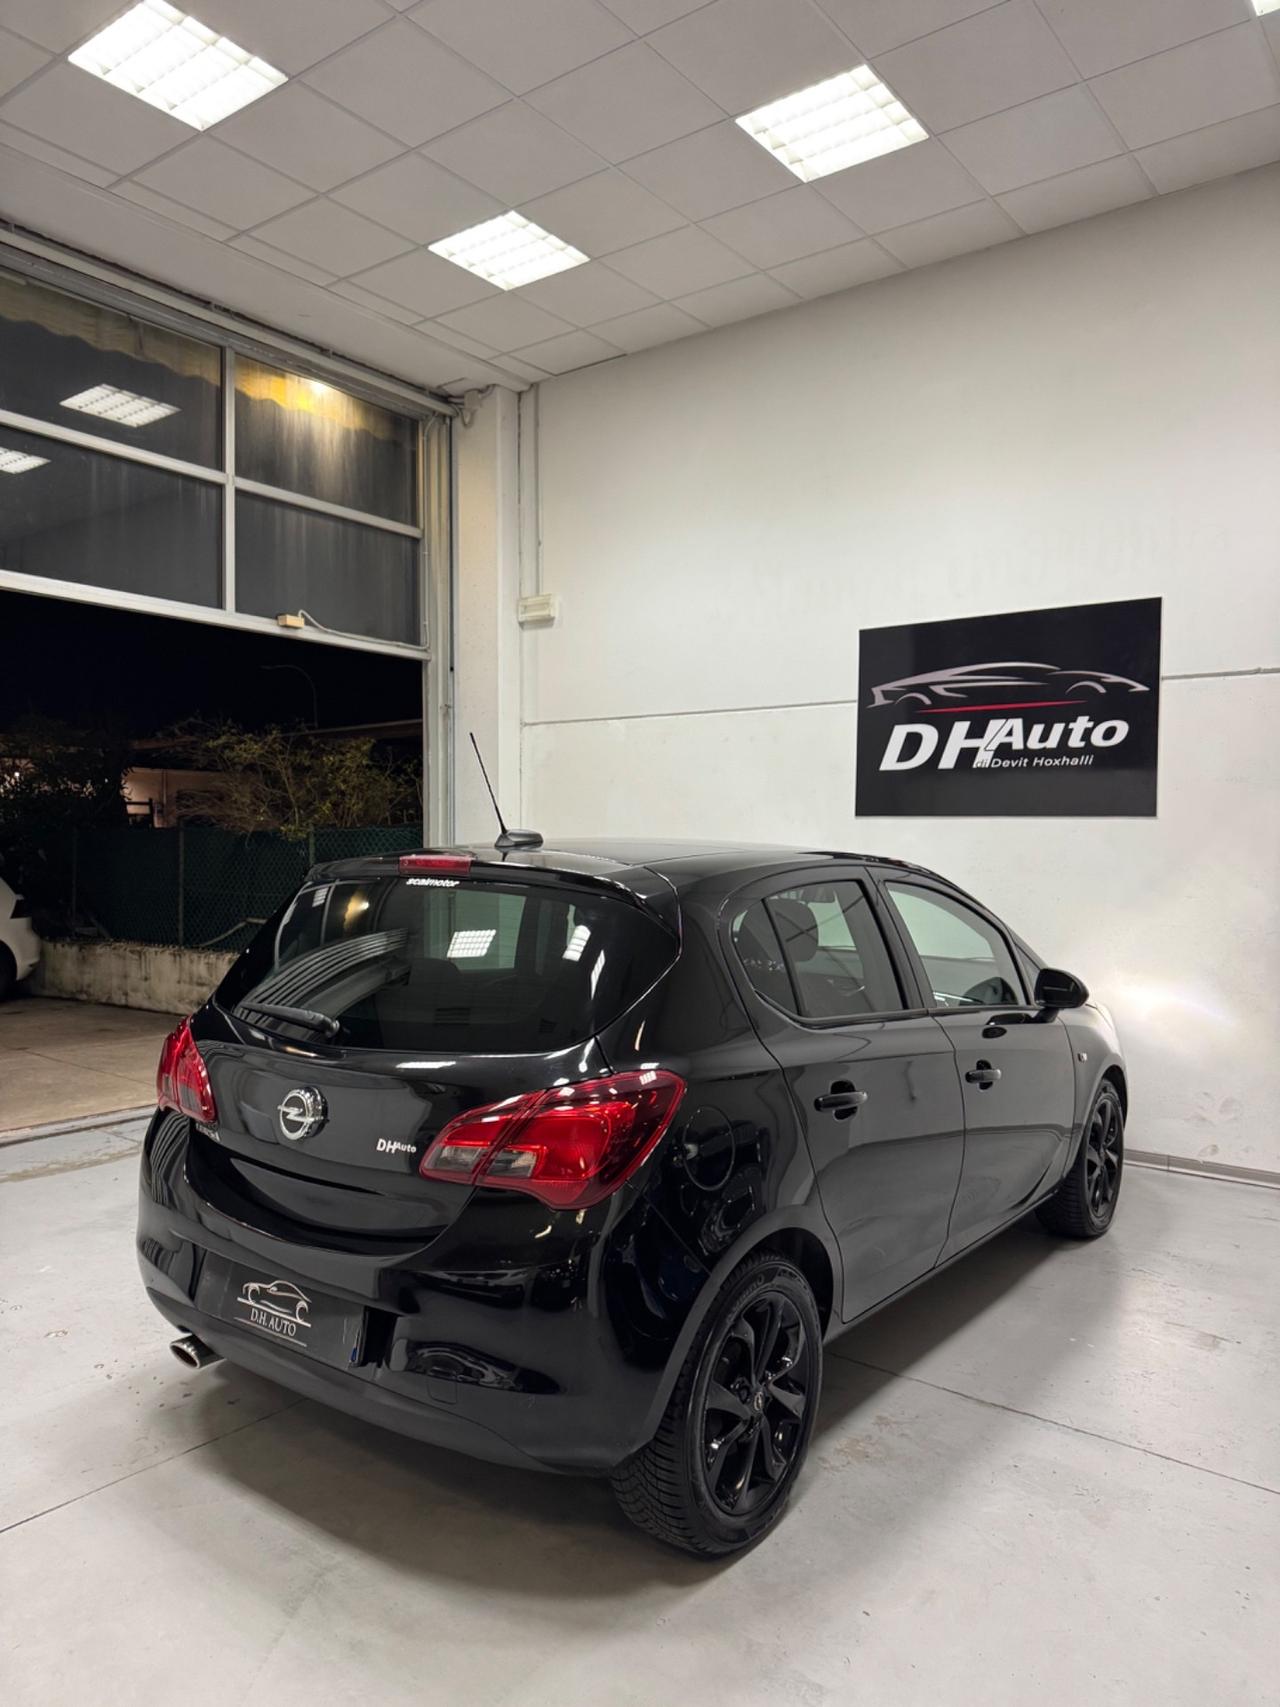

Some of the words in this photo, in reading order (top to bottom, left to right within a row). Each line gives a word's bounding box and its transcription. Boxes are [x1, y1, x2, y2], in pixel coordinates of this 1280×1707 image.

[990, 757, 1029, 768] Devit
[1032, 755, 1094, 767] Hoxhalli
[268, 1316, 297, 1337] AUTO
